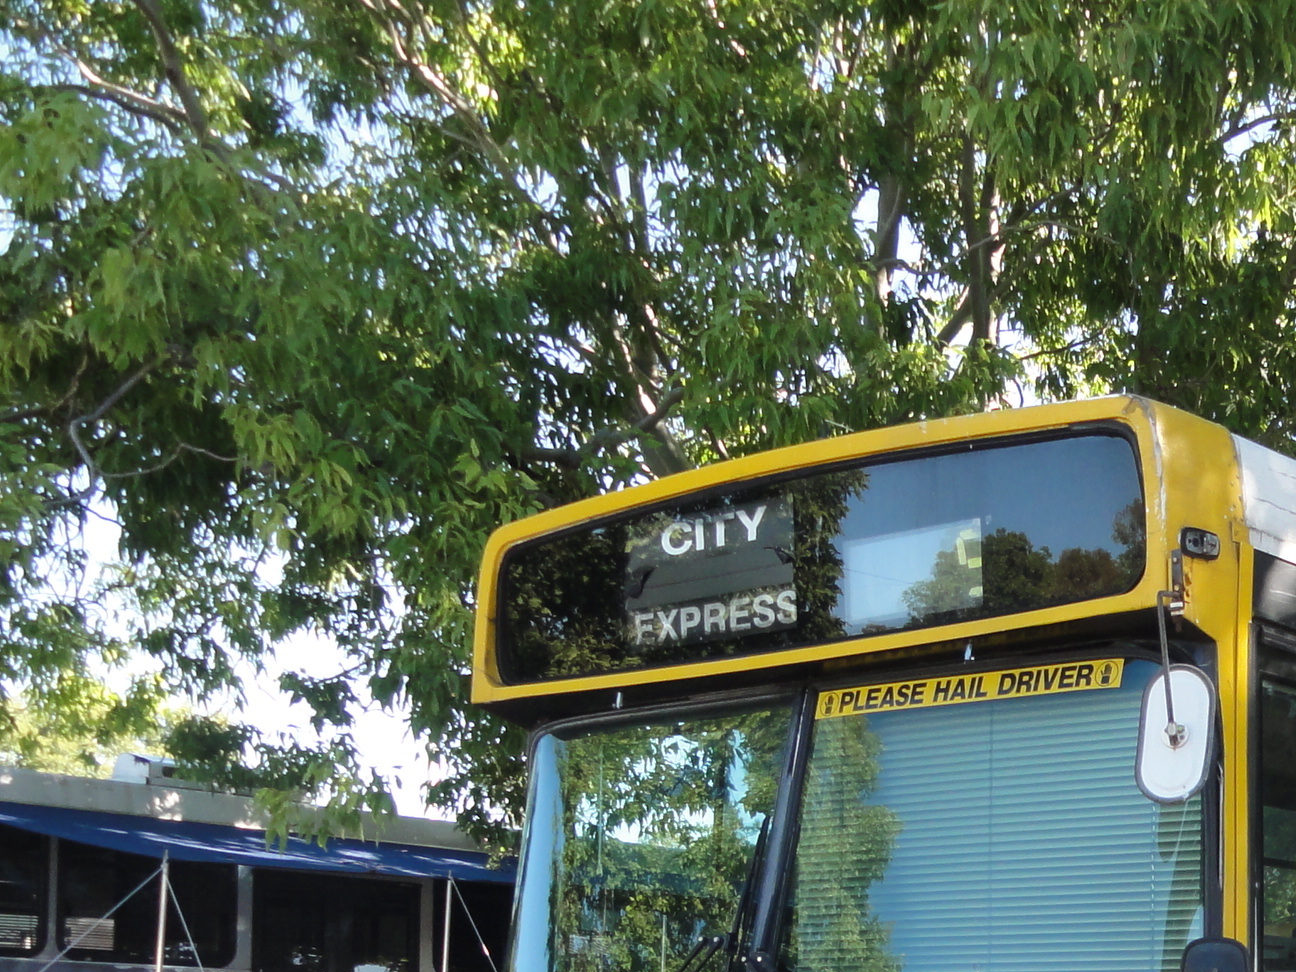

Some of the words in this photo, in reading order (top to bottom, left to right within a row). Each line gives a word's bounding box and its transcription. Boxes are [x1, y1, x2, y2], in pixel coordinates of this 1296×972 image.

[661, 505, 767, 556] CITY
[635, 590, 797, 646] EXPRESS
[838, 682, 925, 714] PLEASE
[933, 676, 987, 702] HAIL
[998, 664, 1095, 696] DRIVER
